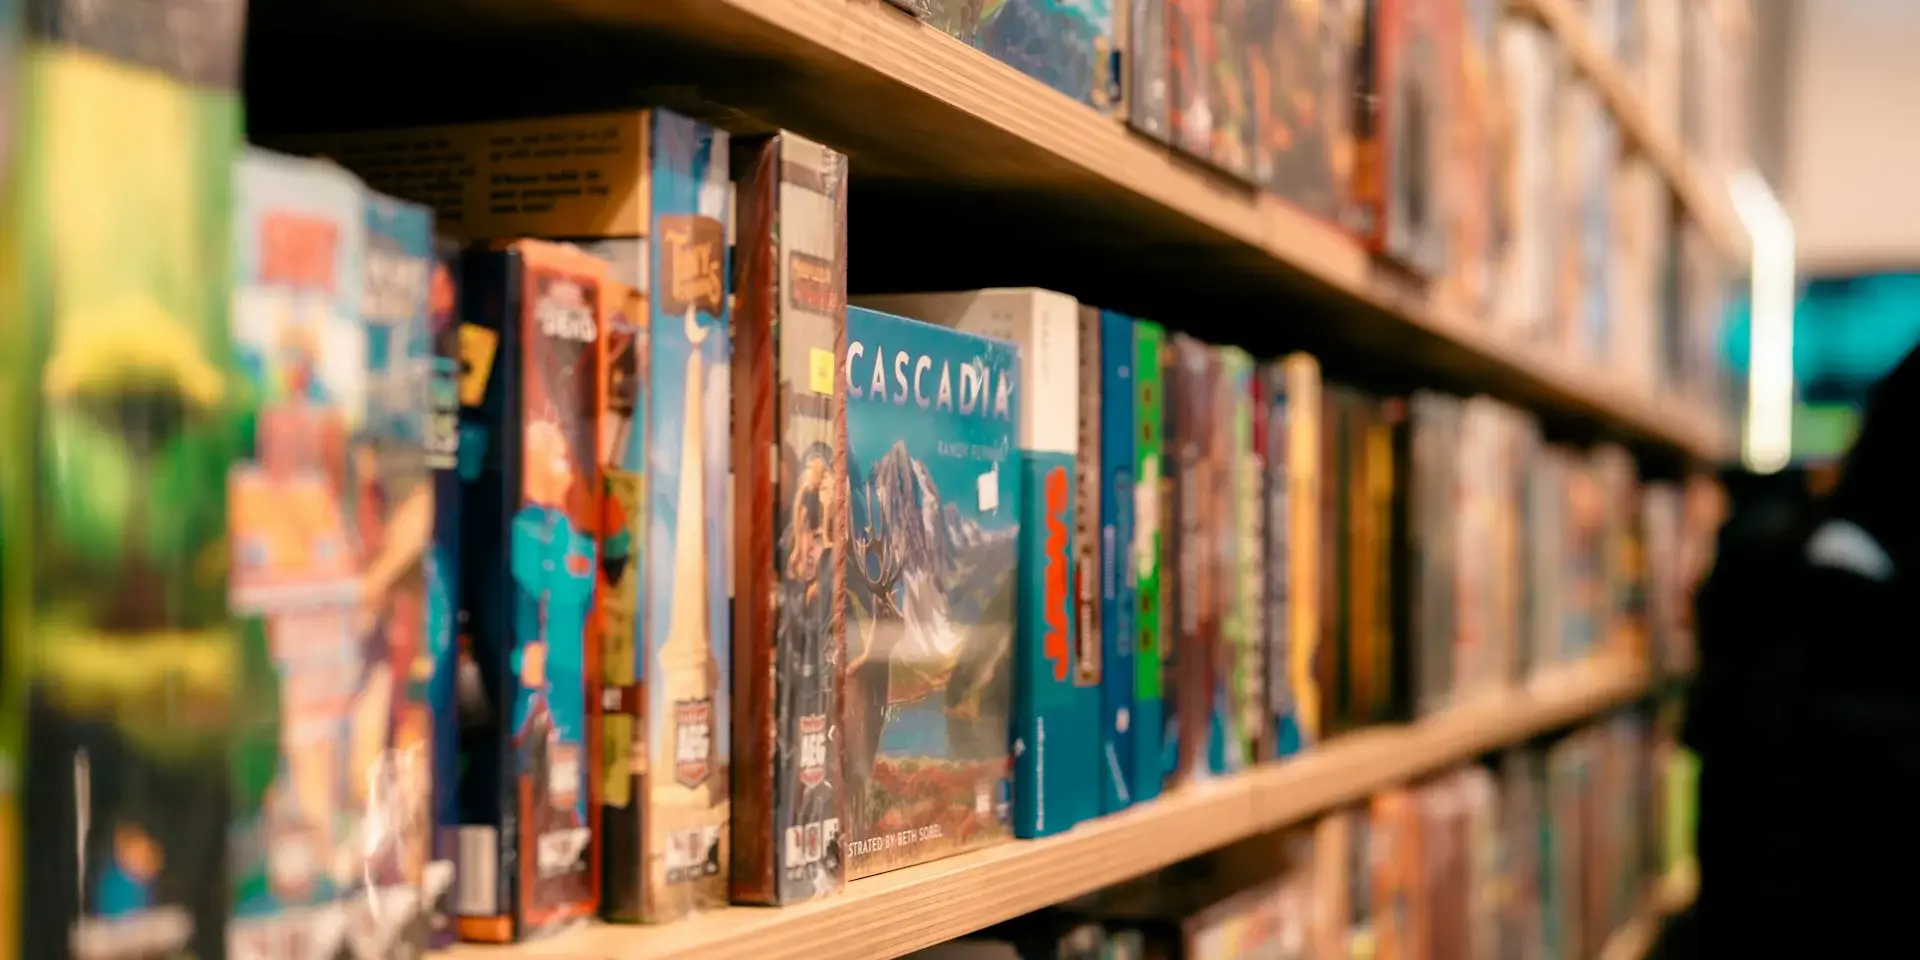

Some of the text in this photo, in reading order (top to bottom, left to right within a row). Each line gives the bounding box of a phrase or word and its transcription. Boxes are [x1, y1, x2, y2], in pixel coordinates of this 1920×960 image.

[846, 341, 1010, 421] CASCADIA
[1045, 465, 1069, 681] JAWS
[800, 733, 827, 769] AEG
[848, 823, 944, 857] STRATED BY BETH SOBEL
